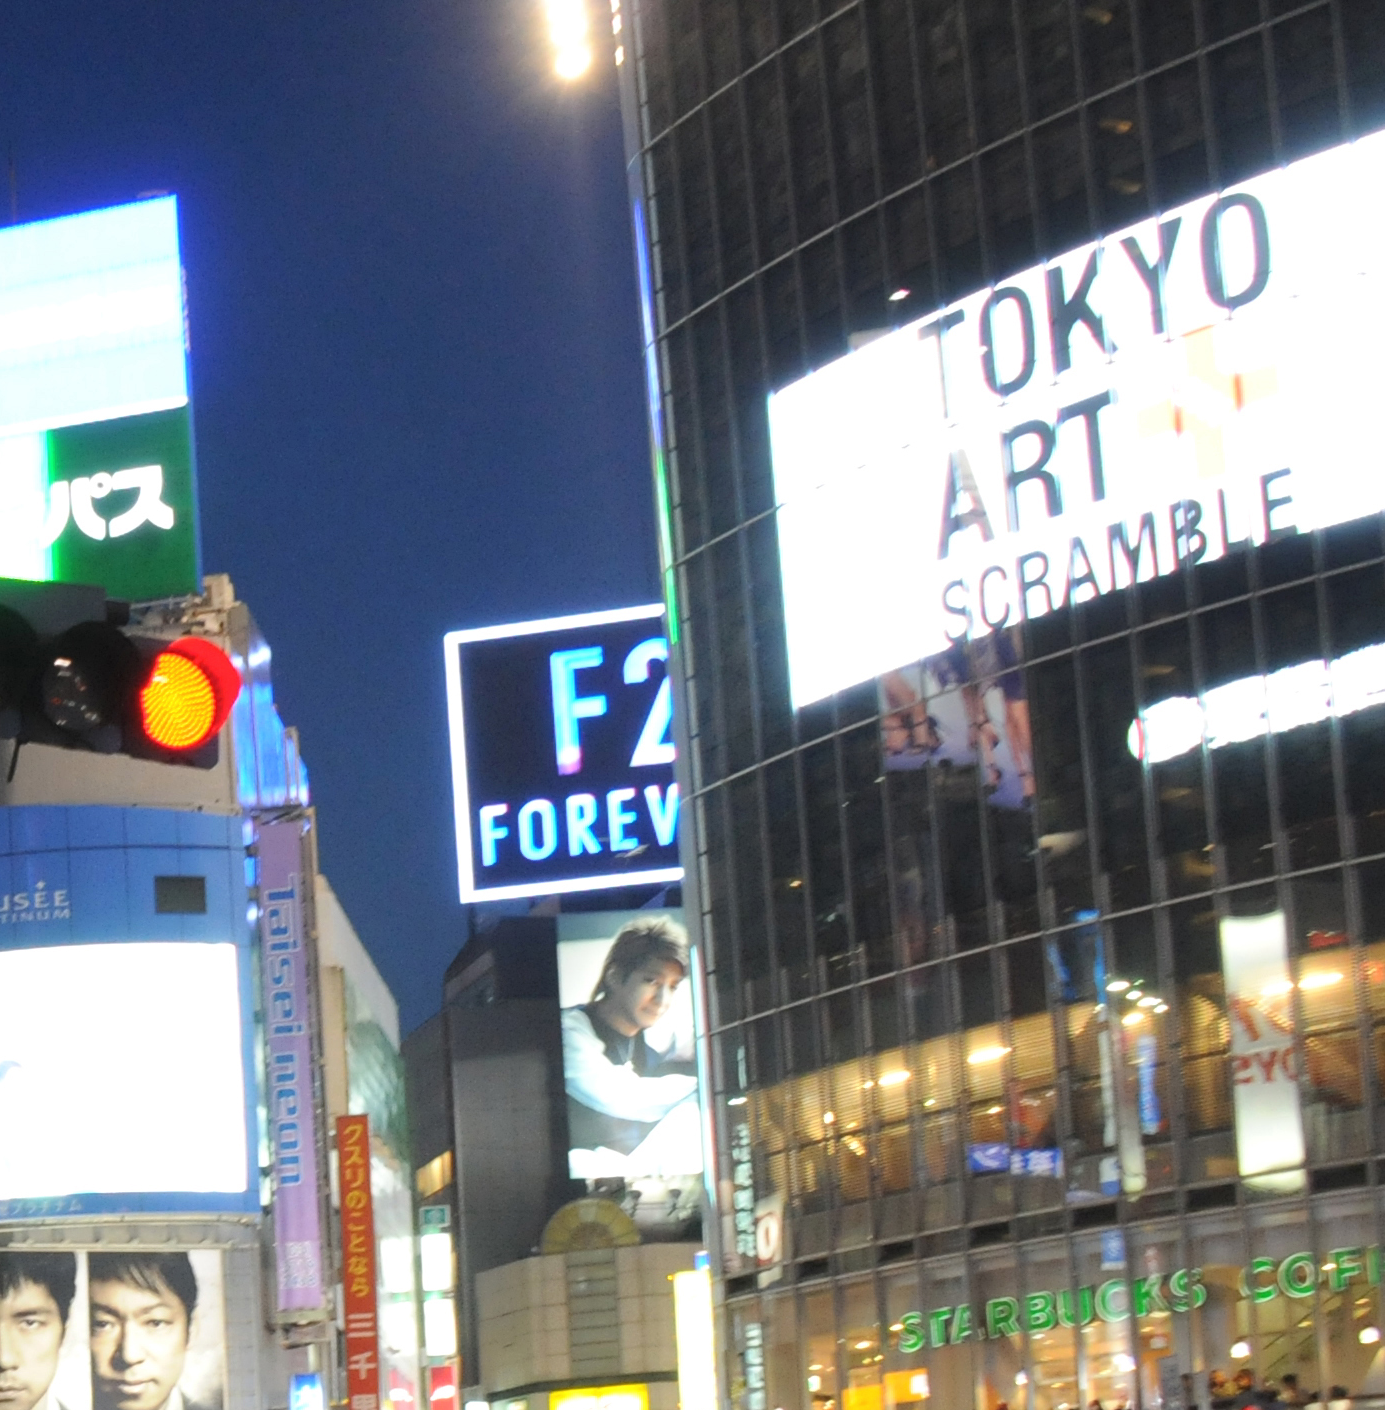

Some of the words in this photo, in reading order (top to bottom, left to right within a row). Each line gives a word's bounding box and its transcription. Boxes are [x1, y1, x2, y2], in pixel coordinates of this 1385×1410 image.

[919, 192, 1271, 418] TOKYO
[937, 389, 1118, 559] ART
[941, 467, 1297, 647] SCRAMBLE
[267, 874, 306, 1037] Taisei
[275, 1052, 303, 1187] neon
[342, 1123, 371, 1298] クスリのことなら
[899, 1267, 1206, 1353] STARBUCKS
